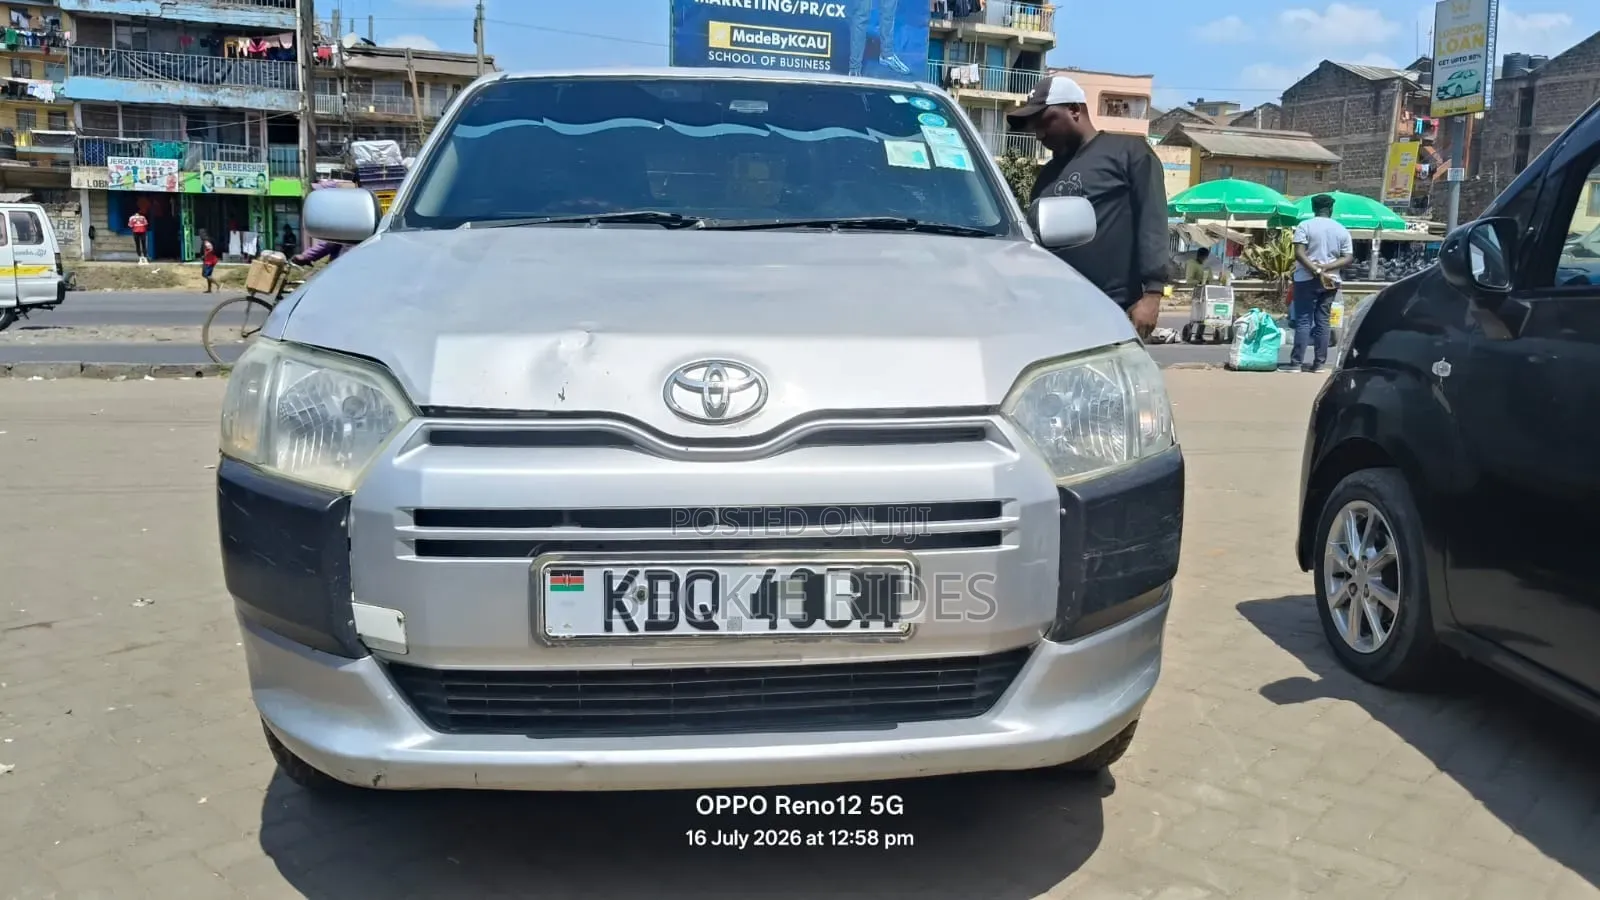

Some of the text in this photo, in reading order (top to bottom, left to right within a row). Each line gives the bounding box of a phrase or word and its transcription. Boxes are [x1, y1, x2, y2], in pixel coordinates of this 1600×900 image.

[695, 0, 846, 18] KETING/PR/CX
[733, 29, 827, 49] MadeByKCAU
[1437, 33, 1484, 56] LOAN
[708, 50, 831, 71] SCHOOL OF BUSINESS
[203, 162, 266, 172] VIP BARBERSHOP
[603, 569, 719, 632] KDQ
